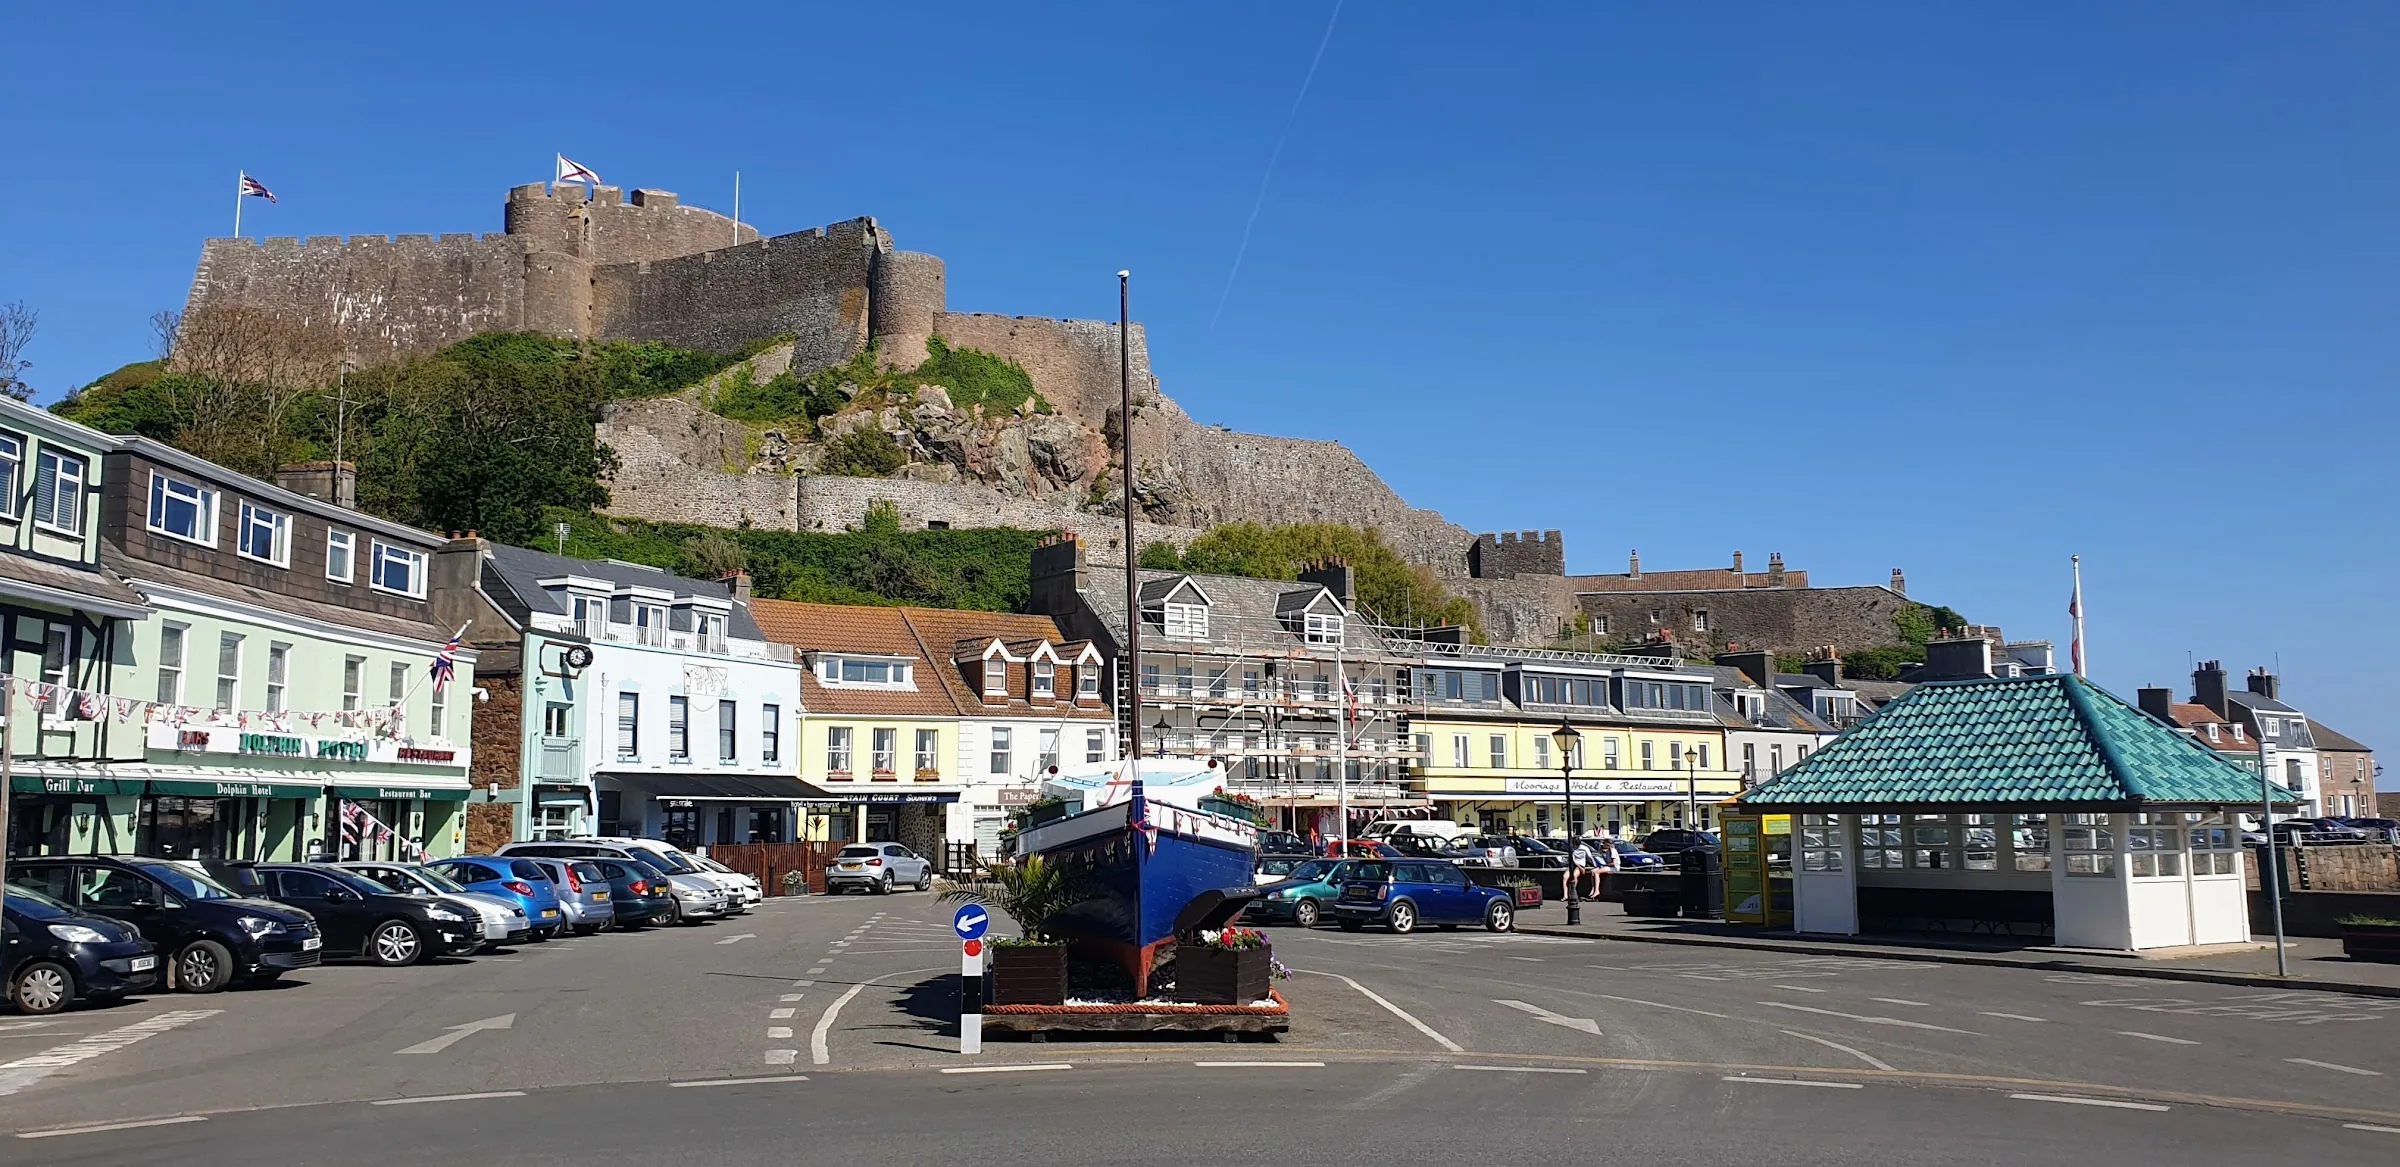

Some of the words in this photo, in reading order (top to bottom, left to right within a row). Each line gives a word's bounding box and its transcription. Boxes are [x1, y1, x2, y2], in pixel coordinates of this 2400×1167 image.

[240, 733, 302, 753] DOLPHIN
[318, 740, 367, 758] HOTEL
[46, 778, 70, 792] Grill
[77, 779, 95, 792] Bar
[217, 783, 247, 796] Dolphin
[252, 785, 272, 796] Hotel
[1513, 780, 1560, 793] Moorings
[1571, 781, 1599, 790] Hotel
[1619, 780, 1673, 791] Restaurant
[380, 788, 416, 798] Restaurant
[420, 789, 432, 798] Bar
[871, 793, 900, 802] COURT
[1003, 792, 1018, 801] The
[1020, 792, 1040, 803] Paper
